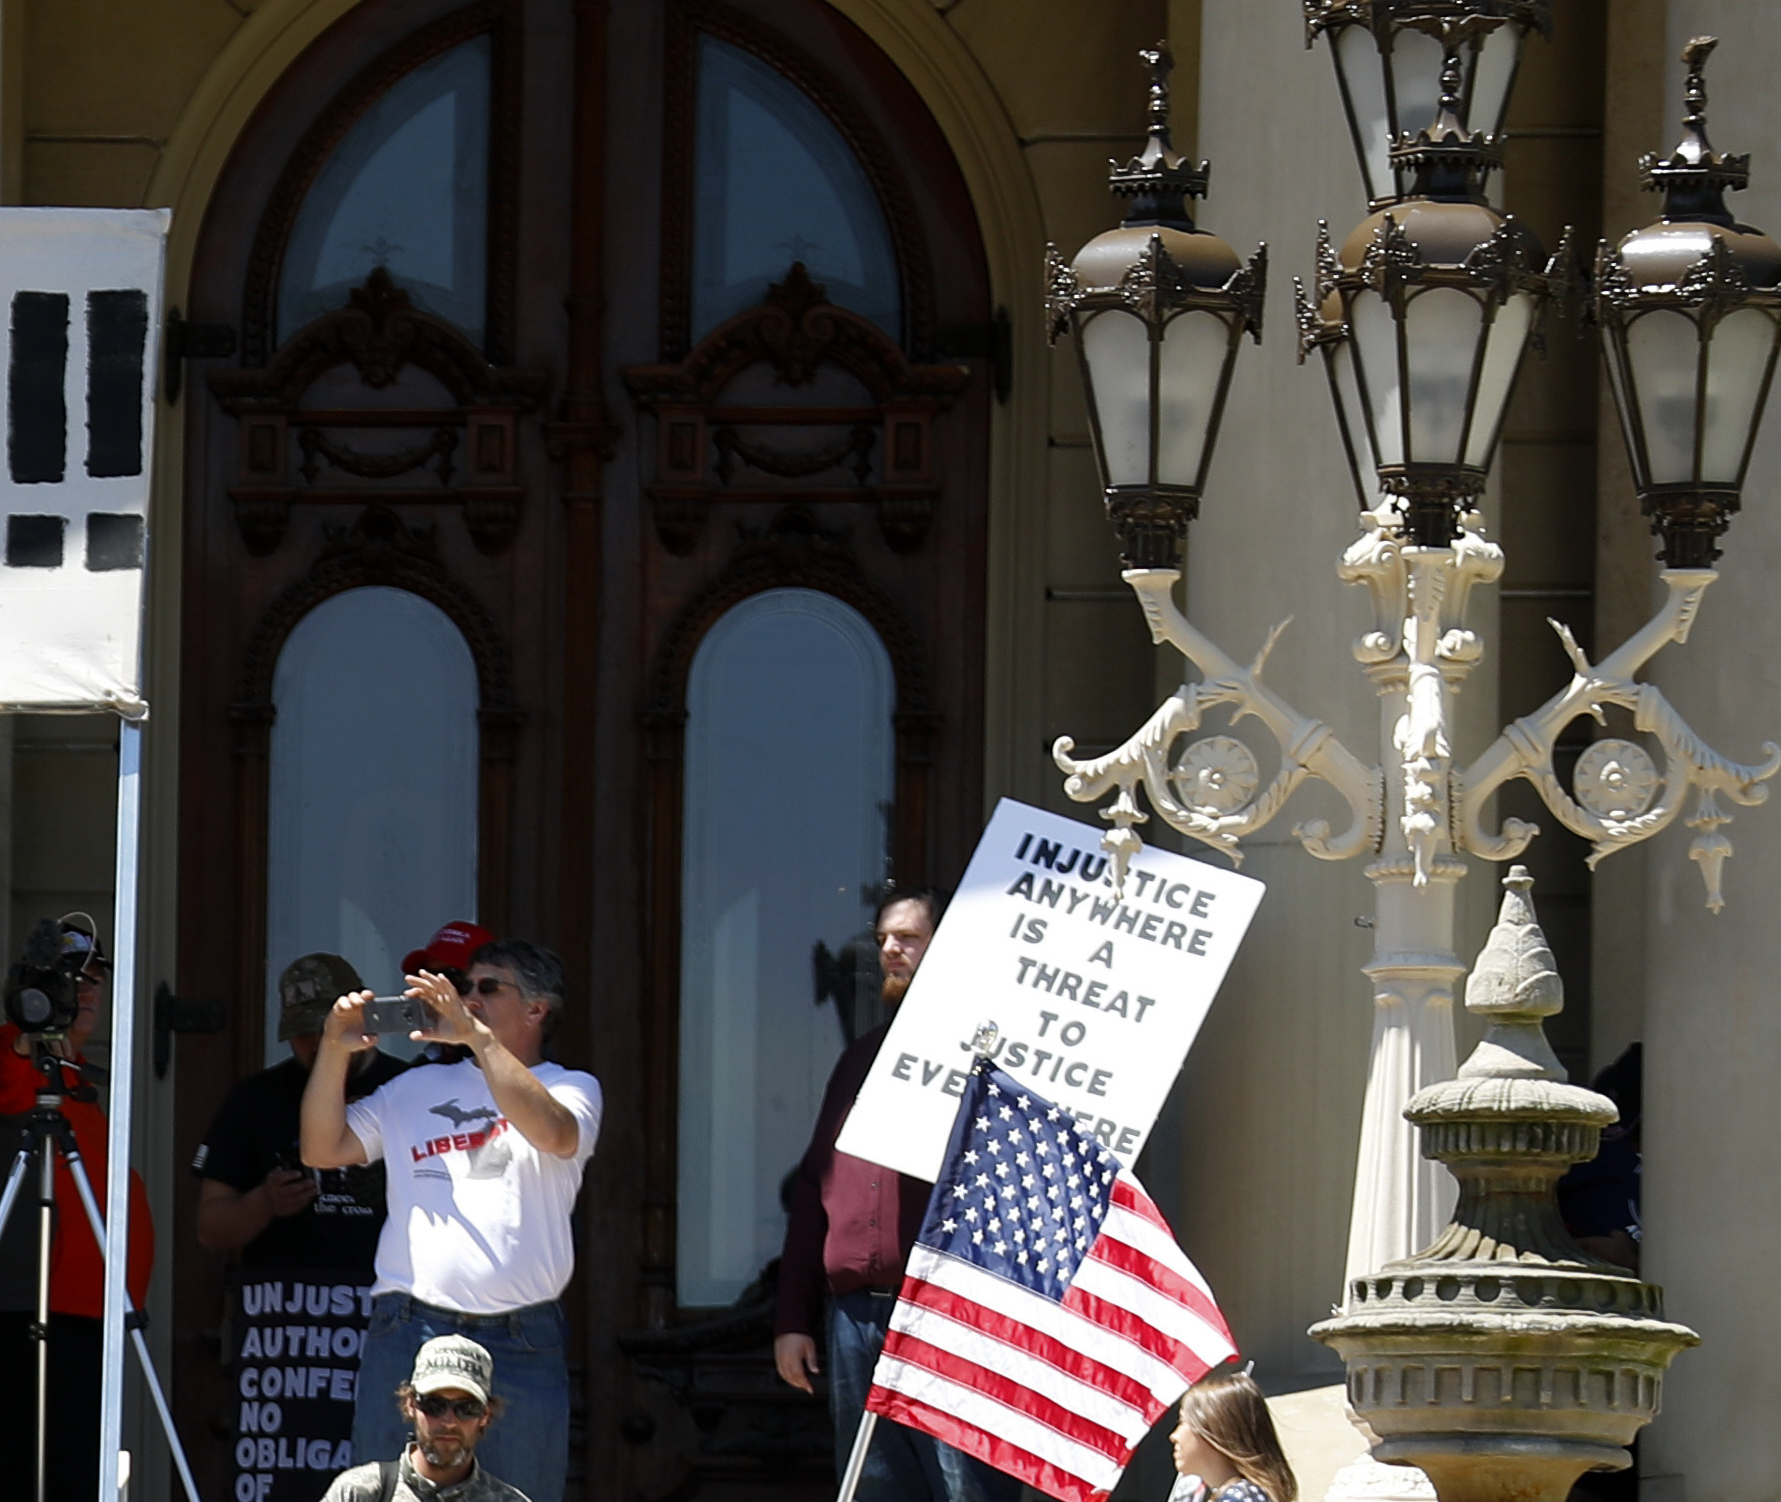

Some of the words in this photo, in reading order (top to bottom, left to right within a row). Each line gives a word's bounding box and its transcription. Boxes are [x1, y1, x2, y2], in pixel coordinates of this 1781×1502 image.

[1005, 871, 1214, 957] ANYWHERE
[1009, 912, 1049, 945] IS
[1087, 940, 1115, 969] A
[1015, 956, 1156, 1023] THREAT
[1035, 1010, 1087, 1048] TO
[242, 1281, 373, 1318] UNJUST
[240, 1366, 360, 1401] CONFE
[240, 1401, 283, 1432] NO
